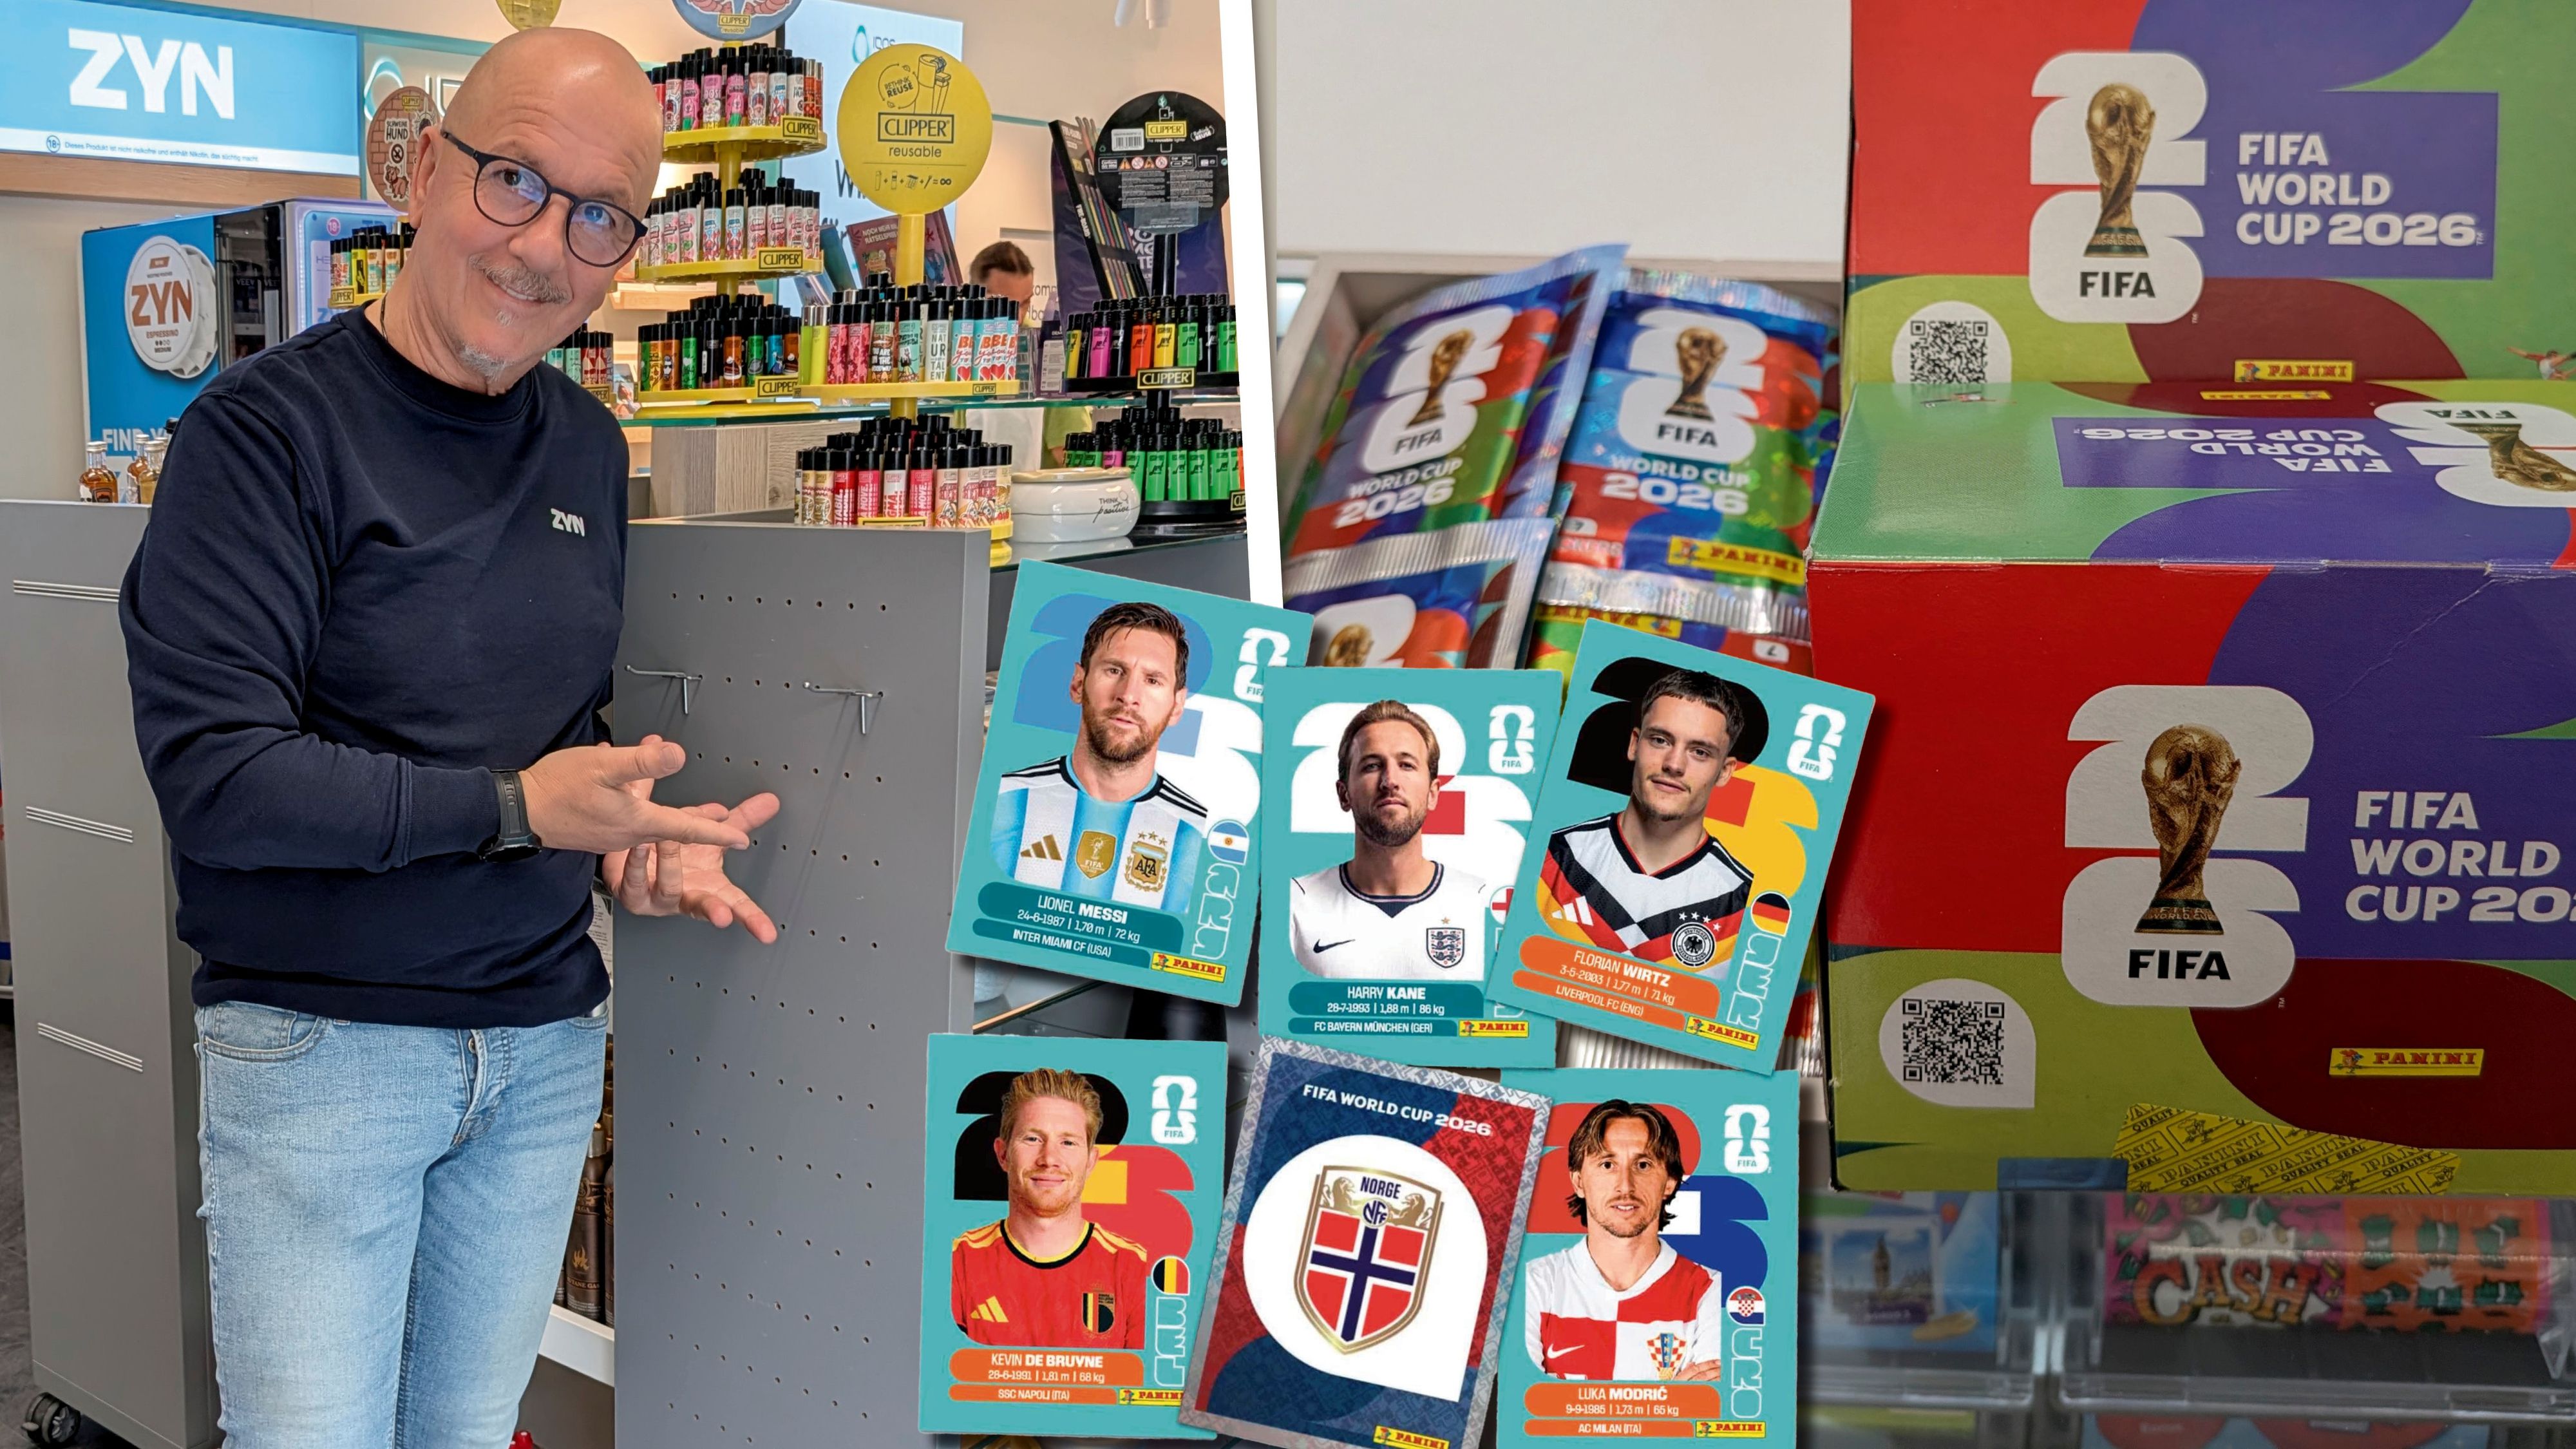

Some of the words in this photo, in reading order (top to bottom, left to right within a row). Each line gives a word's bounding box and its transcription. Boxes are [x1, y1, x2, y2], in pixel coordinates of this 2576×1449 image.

[721, 17, 749, 26] CLIPPER
[68, 28, 235, 120] ZYN
[884, 75, 911, 90] RETHINK
[886, 82, 914, 98] REUSE
[386, 128, 408, 140] HUND
[786, 122, 816, 135] CLIPPER
[884, 118, 947, 137] CLIPPER
[1150, 126, 1182, 134] CLIPPER
[65, 141, 84, 149] Dieses
[86, 143, 108, 151] Produkt
[222, 153, 241, 162] süchtig
[889, 146, 942, 158] reusable
[2238, 133, 2329, 167] FIFA
[2237, 173, 2391, 207] WORLD
[2236, 213, 2320, 246] CUP
[2327, 214, 2476, 247] 2026
[763, 253, 800, 265] CLIPPER
[2079, 271, 2156, 298] FIFA
[131, 279, 193, 327] ZYN
[931, 334, 946, 343] NAT
[1157, 332, 1172, 348] jet
[1182, 332, 1197, 346] jet
[931, 343, 946, 356] UR
[931, 361, 945, 370] TAL
[2268, 363, 2348, 380] PANINI
[931, 371, 945, 380] ENT
[1142, 371, 1189, 385] CLIPPER
[2425, 408, 2518, 419] FIFA
[1394, 428, 1444, 455] FIFA
[1657, 423, 1718, 447] FIFA
[2081, 428, 2257, 440] 2026
[2265, 429, 2367, 442] CUP
[2188, 442, 2383, 457] WORLD
[1609, 453, 1699, 480] WORLD
[1701, 468, 1750, 489] CUP
[2273, 457, 2394, 473] FIFA
[1349, 468, 1419, 498] WORLD
[1420, 457, 1463, 479] CUP
[1601, 473, 1749, 515] 2026
[1334, 477, 1454, 529] 2026
[1092, 502, 1130, 523] positive
[550, 507, 585, 537] ZYN
[1709, 545, 1801, 573] PANINI
[1502, 760, 1522, 768] FIFA
[1799, 759, 1821, 773] FIFA
[2354, 791, 2479, 830] FIFA
[1084, 859, 1102, 868] FIFA
[1135, 854, 1157, 878] AFA
[2349, 839, 2561, 878] WORLD
[1037, 895, 1075, 914] LIONEL
[1078, 904, 1128, 923] MESSI
[2345, 884, 2461, 923] CUP
[2469, 885, 2576, 923] 20
[1017, 909, 1065, 928] 24-6-1987
[1074, 920, 1094, 934] 1,70
[1095, 926, 1104, 935] m
[1115, 928, 1126, 939] 72
[1128, 931, 1141, 943] kg
[1013, 929, 1041, 943] INTER
[1041, 934, 1072, 950] MIAMI
[1073, 940, 1086, 952] CF
[1087, 943, 1112, 958] (USA)
[1173, 959, 1223, 976] PANINI
[1574, 951, 1620, 973] FLORIAN
[1622, 964, 1671, 988] WIRTZ
[2128, 949, 2231, 980] FIFA
[1347, 987, 1383, 999] HARRY
[1387, 987, 1426, 999] KANE
[1560, 965, 1604, 985] 3-5-2003
[1612, 979, 1629, 993] 1,77
[1631, 986, 1641, 995] m
[1651, 989, 1661, 1000] 71
[1662, 992, 1676, 1006] kg
[1327, 1003, 1370, 1014] 28-7-1993
[1380, 1003, 1399, 1015] 1,88
[1419, 1004, 1432, 1014] 86
[1434, 1005, 1444, 1016] kg
[1556, 985, 1606, 1008] LIVERPOOL
[1607, 998, 1619, 1010] FC
[1620, 1001, 1644, 1018] (ENG)
[1314, 1021, 1326, 1031] FC
[1327, 1021, 1364, 1032] BAYERN
[1365, 1020, 1410, 1032] MÜNCHEN
[1410, 1021, 1433, 1034] (GER)
[1479, 1023, 1526, 1032] PANINI
[1707, 1023, 1756, 1045] PANINI
[2372, 1050, 2477, 1066] PANINI
[1303, 1084, 1339, 1102] FIFA
[1341, 1092, 1397, 1115] WORLD
[1399, 1104, 1434, 1122] CUP
[1434, 1112, 1492, 1135] 2026
[1164, 1130, 1184, 1138] FIFA
[2132, 1157, 2162, 1171] SEAL
[2158, 1132, 2266, 1184] PANINI
[2281, 1159, 2331, 1181] QUALITY
[2337, 1144, 2365, 1160] SEAL
[2382, 1152, 2432, 1177] QUALITY
[2180, 1162, 2228, 1188] QUALITY
[2235, 1150, 2263, 1166] SEAL
[1360, 1176, 1402, 1199] NORGE
[2134, 1256, 2316, 1325] CASH
[990, 1353, 1022, 1366] KEVIN
[1025, 1354, 1043, 1367] DE
[1046, 1354, 1103, 1368] BRUYNE
[988, 1370, 1032, 1381] 28-6-1991
[1041, 1371, 1059, 1383] 1,81
[1079, 1372, 1092, 1383] 68
[1093, 1372, 1105, 1384] kg
[998, 1390, 1016, 1399] SSC
[1018, 1390, 1050, 1400] NAPOLI
[1051, 1390, 1070, 1401] (ITA)
[1578, 1388, 1606, 1401] LUKA
[1609, 1384, 1668, 1401] MODRIĆ
[1566, 1405, 1606, 1414] 9-9-1985
[1615, 1405, 1632, 1416] 1,73
[1653, 1405, 1665, 1415] 65
[1667, 1405, 1679, 1417] kg
[1578, 1423, 1591, 1434] AC
[1592, 1423, 1622, 1434] MILAN
[1623, 1423, 1642, 1435] (ITA)
[1714, 1422, 1763, 1432] PANINI
[1396, 1432, 1447, 1449] PANINI
